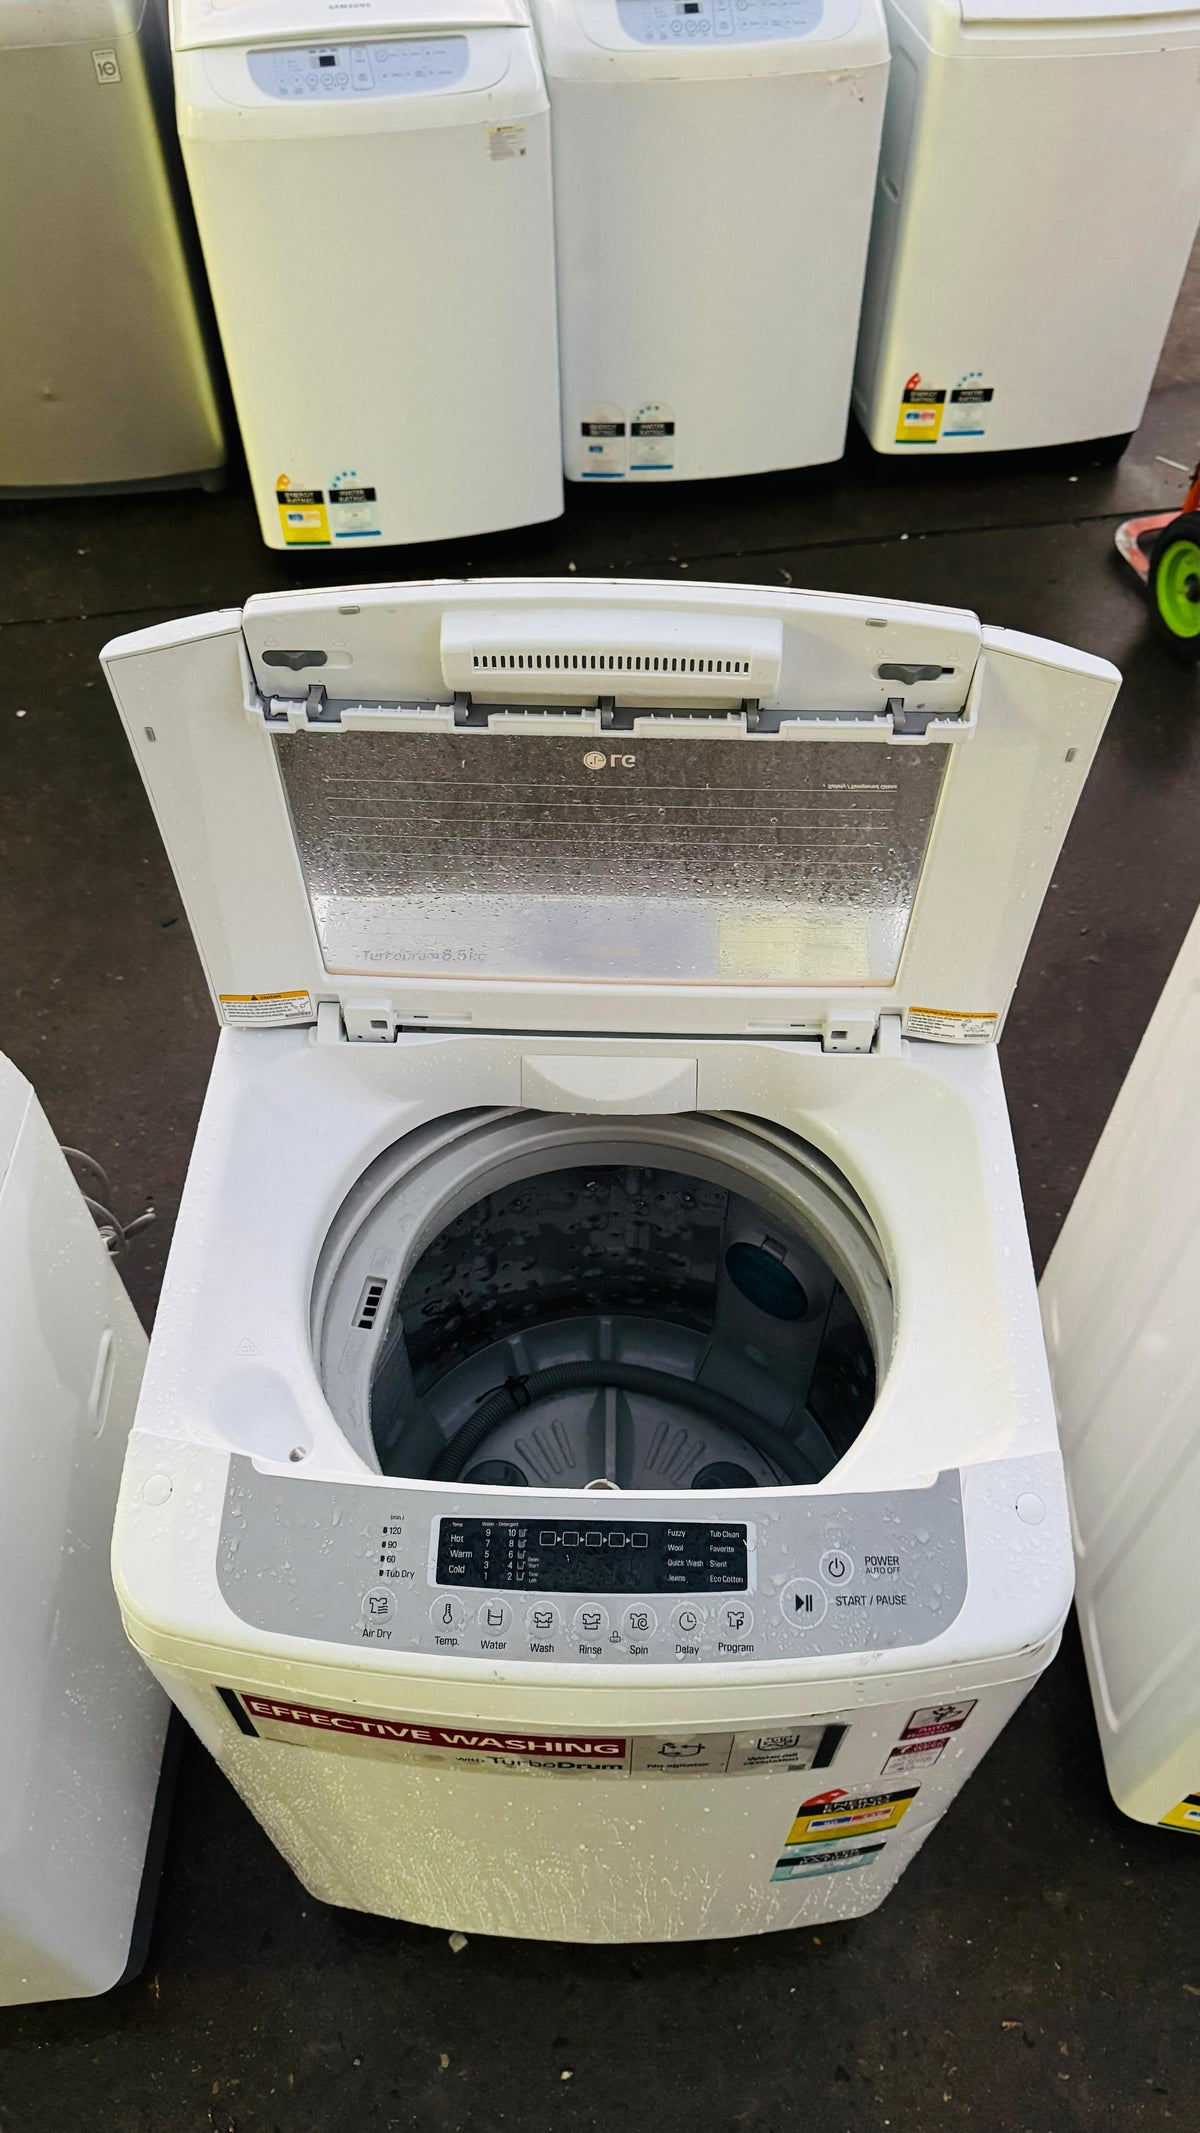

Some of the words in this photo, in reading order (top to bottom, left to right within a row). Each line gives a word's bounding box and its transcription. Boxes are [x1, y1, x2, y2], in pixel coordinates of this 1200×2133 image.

[389, 1527, 402, 1535] 120
[508, 1529, 516, 1537] 10
[668, 1529, 686, 1538] Fuzzy
[710, 1530, 721, 1538] Tub
[451, 1534, 464, 1542] Hot
[387, 1541, 397, 1549] 90
[450, 1550, 472, 1558] Warm
[484, 1550, 490, 1558] 5
[484, 1561, 489, 1569] 3
[668, 1559, 684, 1567] Quick
[686, 1559, 703, 1567] Wash
[710, 1560, 727, 1568] Silent
[864, 1556, 899, 1566] POWER
[449, 1565, 465, 1573] Cold
[385, 1570, 400, 1578] Tub
[401, 1570, 414, 1580] Dry
[507, 1572, 512, 1580] 2
[668, 1574, 686, 1582] Jeans
[836, 1595, 866, 1606] START
[876, 1595, 907, 1605] PAUSE
[362, 1629, 376, 1638] Air
[377, 1630, 392, 1640] Dry
[435, 1636, 459, 1646] Temp.
[481, 1640, 507, 1650] Water
[530, 1643, 554, 1653] Wash
[579, 1645, 602, 1654] Rinse
[630, 1645, 648, 1656] Spin
[676, 1645, 699, 1655] Delay
[718, 1642, 754, 1653] Program
[250, 1700, 434, 1741] EFFECTIVE
[440, 1732, 620, 1754] WASHING
[486, 1756, 622, 1770] TurboDrum
